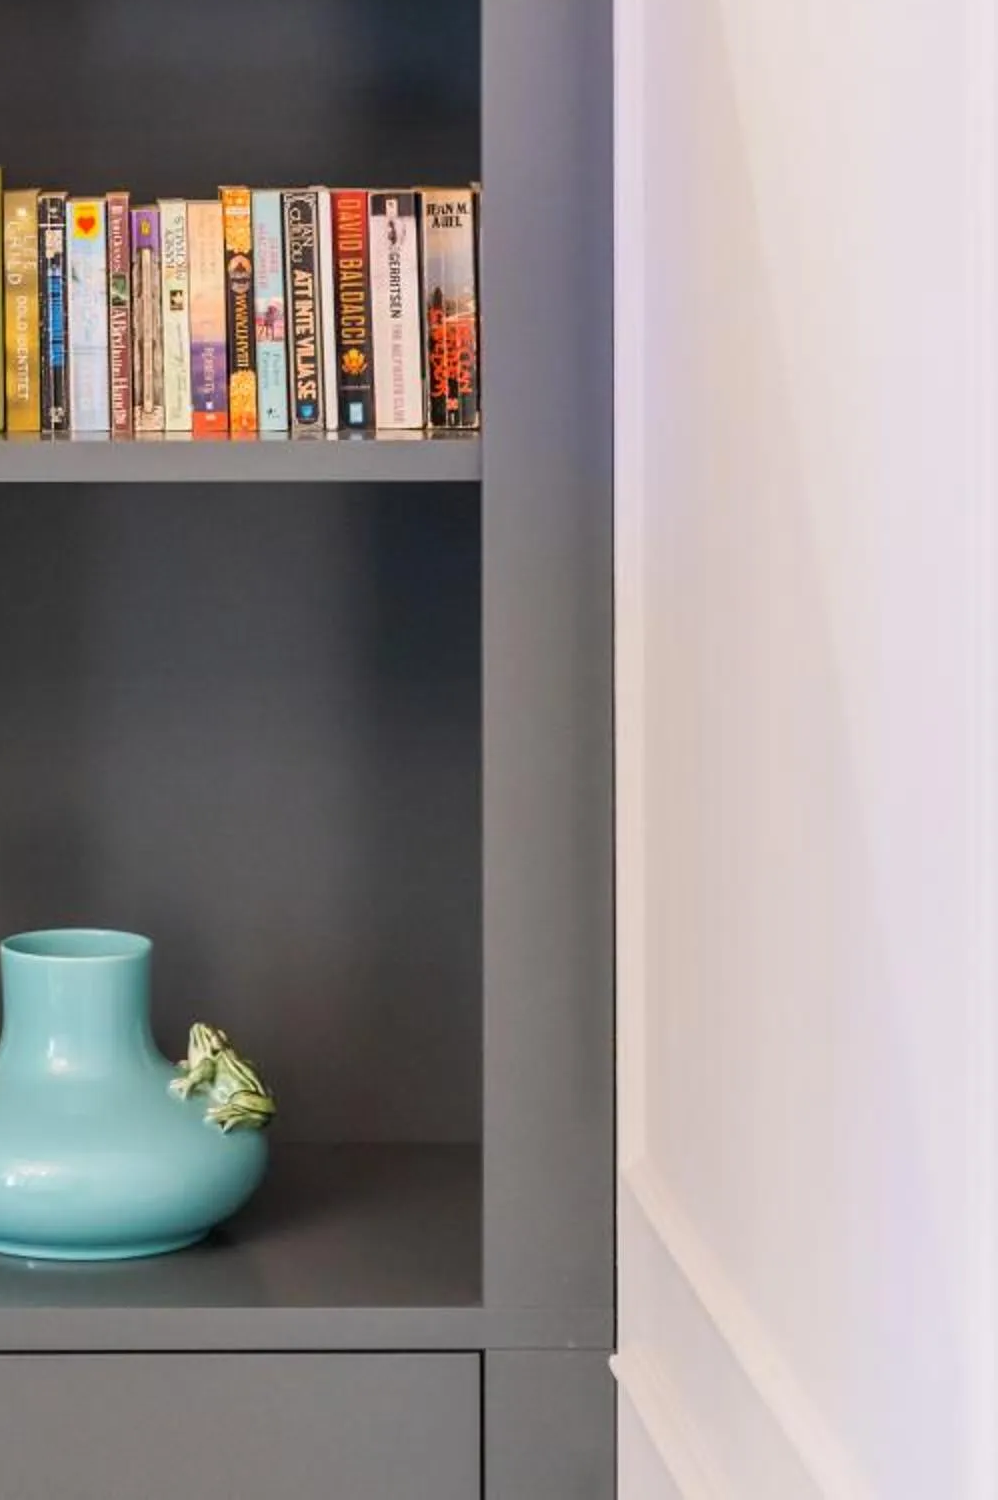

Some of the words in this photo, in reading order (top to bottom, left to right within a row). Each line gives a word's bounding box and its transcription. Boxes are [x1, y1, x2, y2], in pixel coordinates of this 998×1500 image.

[301, 223, 314, 247] JAN
[337, 198, 363, 252] DAVID
[293, 269, 313, 297] ATT
[339, 259, 366, 345] BALDACCI
[389, 252, 403, 319] GERRITSEN
[294, 299, 313, 334] INTE
[296, 336, 315, 379] VILJA
[298, 380, 317, 400] SE
